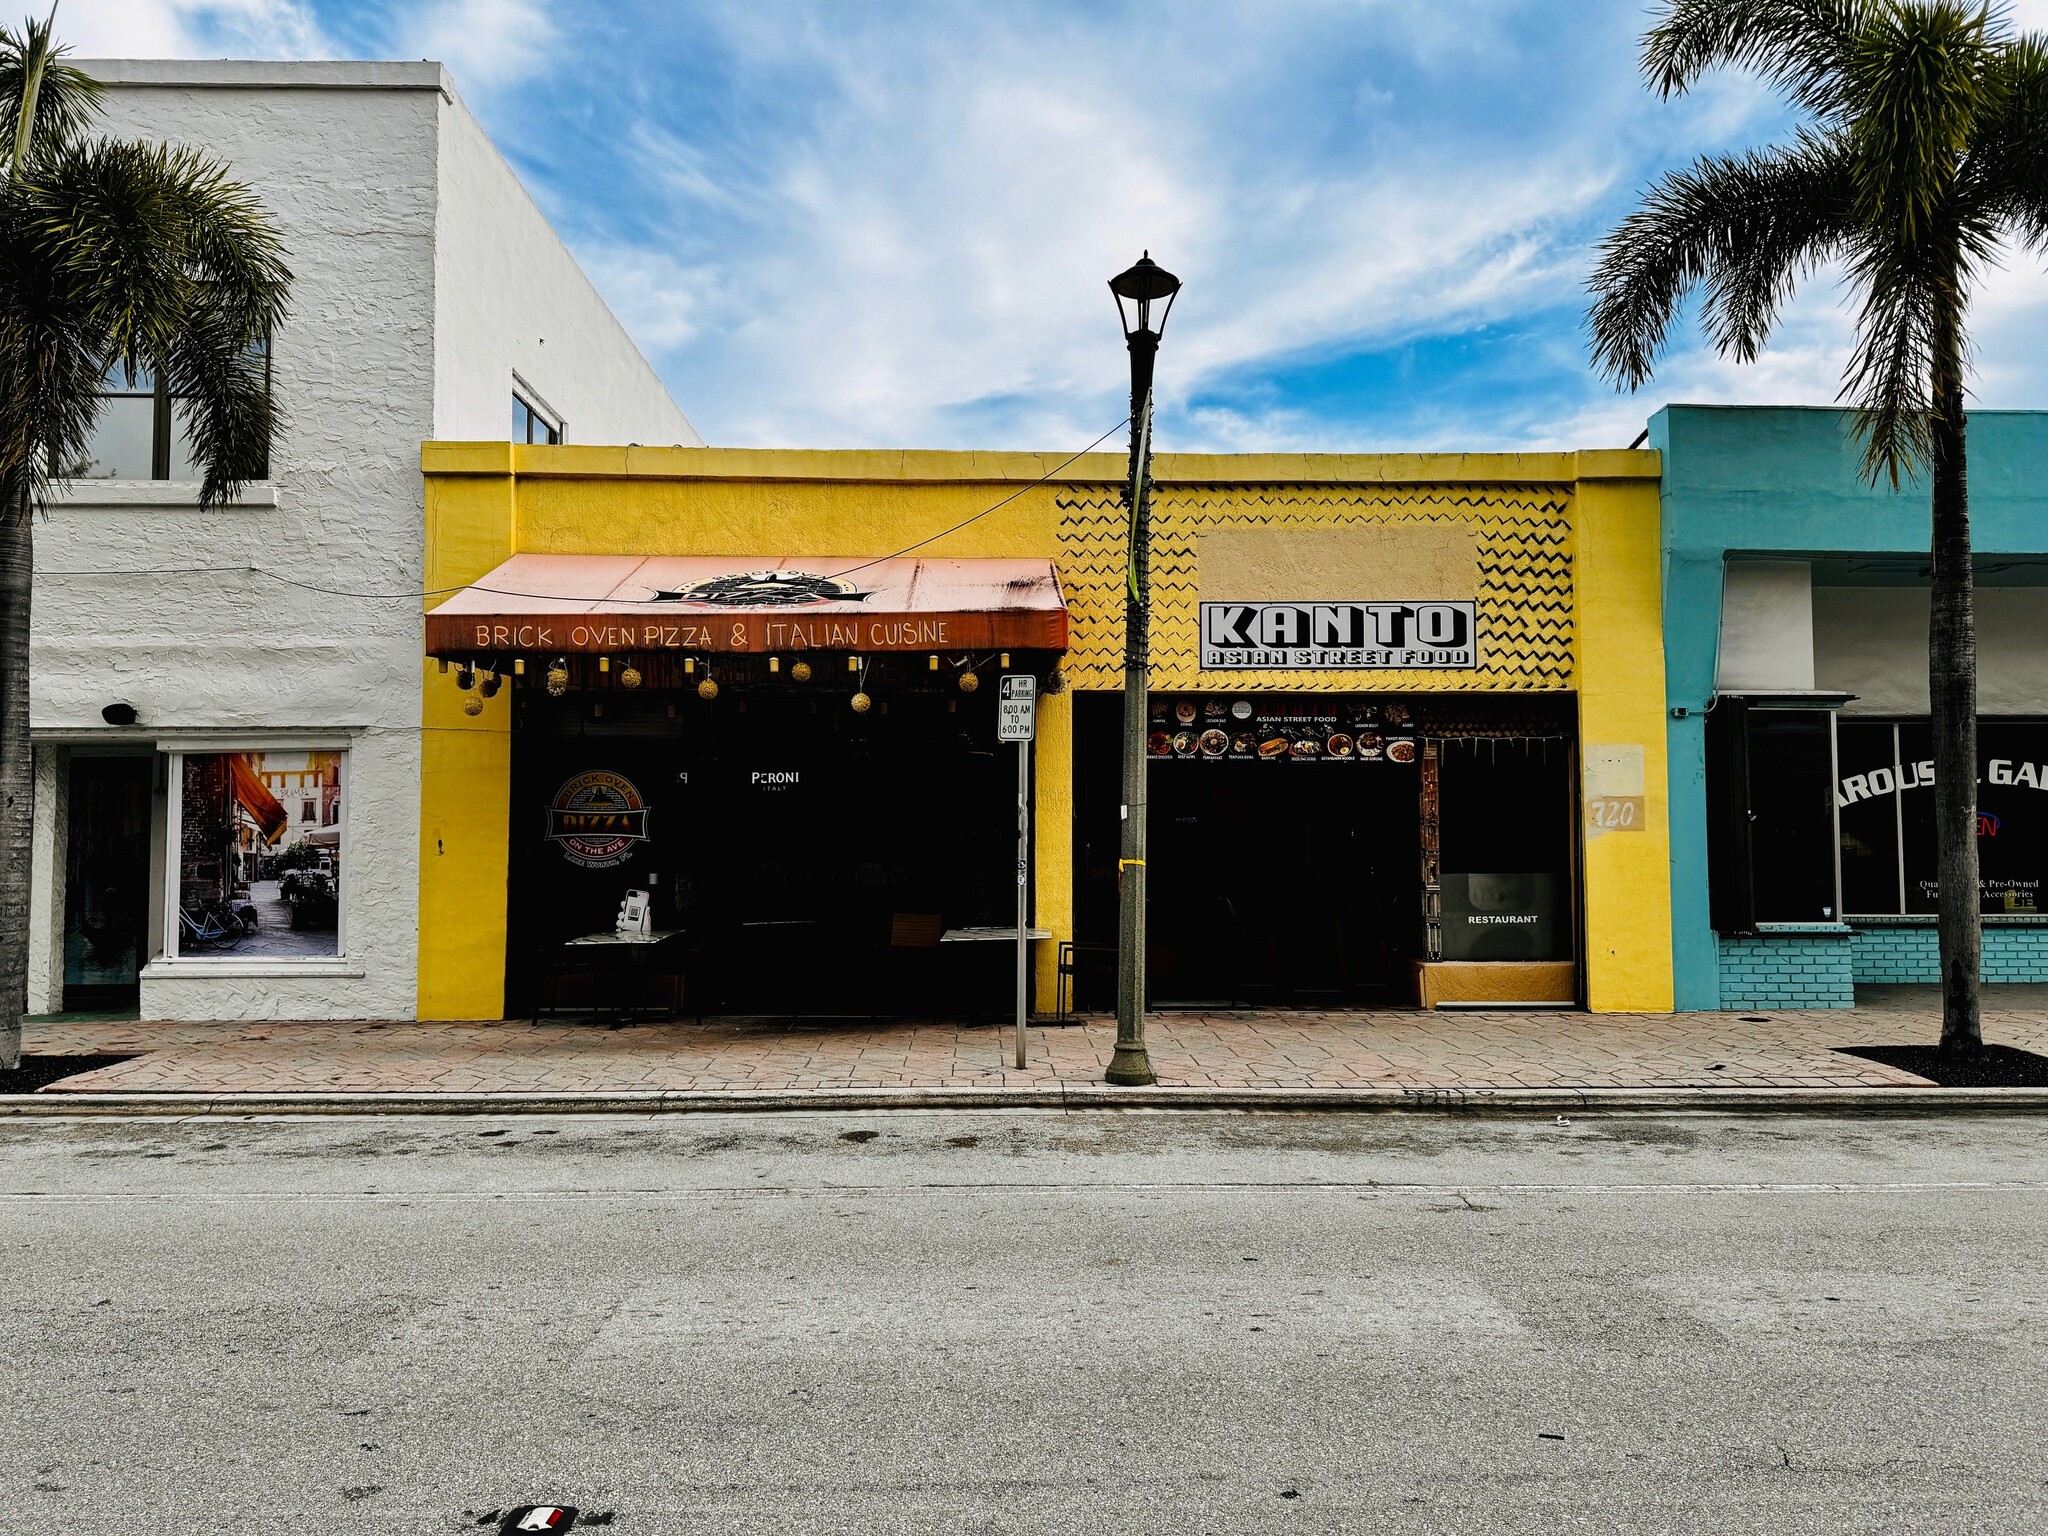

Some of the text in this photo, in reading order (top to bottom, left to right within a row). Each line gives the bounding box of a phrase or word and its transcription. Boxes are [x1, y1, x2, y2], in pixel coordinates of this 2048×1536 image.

[476, 620, 949, 647] BRICK OVEN PIZZA & ITALIAN CUISINE
[1208, 605, 1467, 648] KANTO
[1207, 649, 1469, 665] ASIAN STREET FOOD
[1002, 681, 1010, 697] 4
[1018, 679, 1028, 688] HR
[1011, 689, 1033, 698] PARKING
[1020, 704, 1031, 714] AM
[1011, 715, 1020, 724] TO
[1019, 725, 1030, 734] PM
[751, 771, 799, 785] PERONI
[564, 774, 635, 799] BRICK OVEN
[1591, 801, 1635, 827] 720
[563, 814, 632, 833] PIZZA
[569, 838, 625, 855] ON THE AVE
[1989, 879, 2039, 888] Pre-Owned
[1982, 890, 2034, 899] Accessories
[1468, 915, 1538, 924] RESTAURANT
